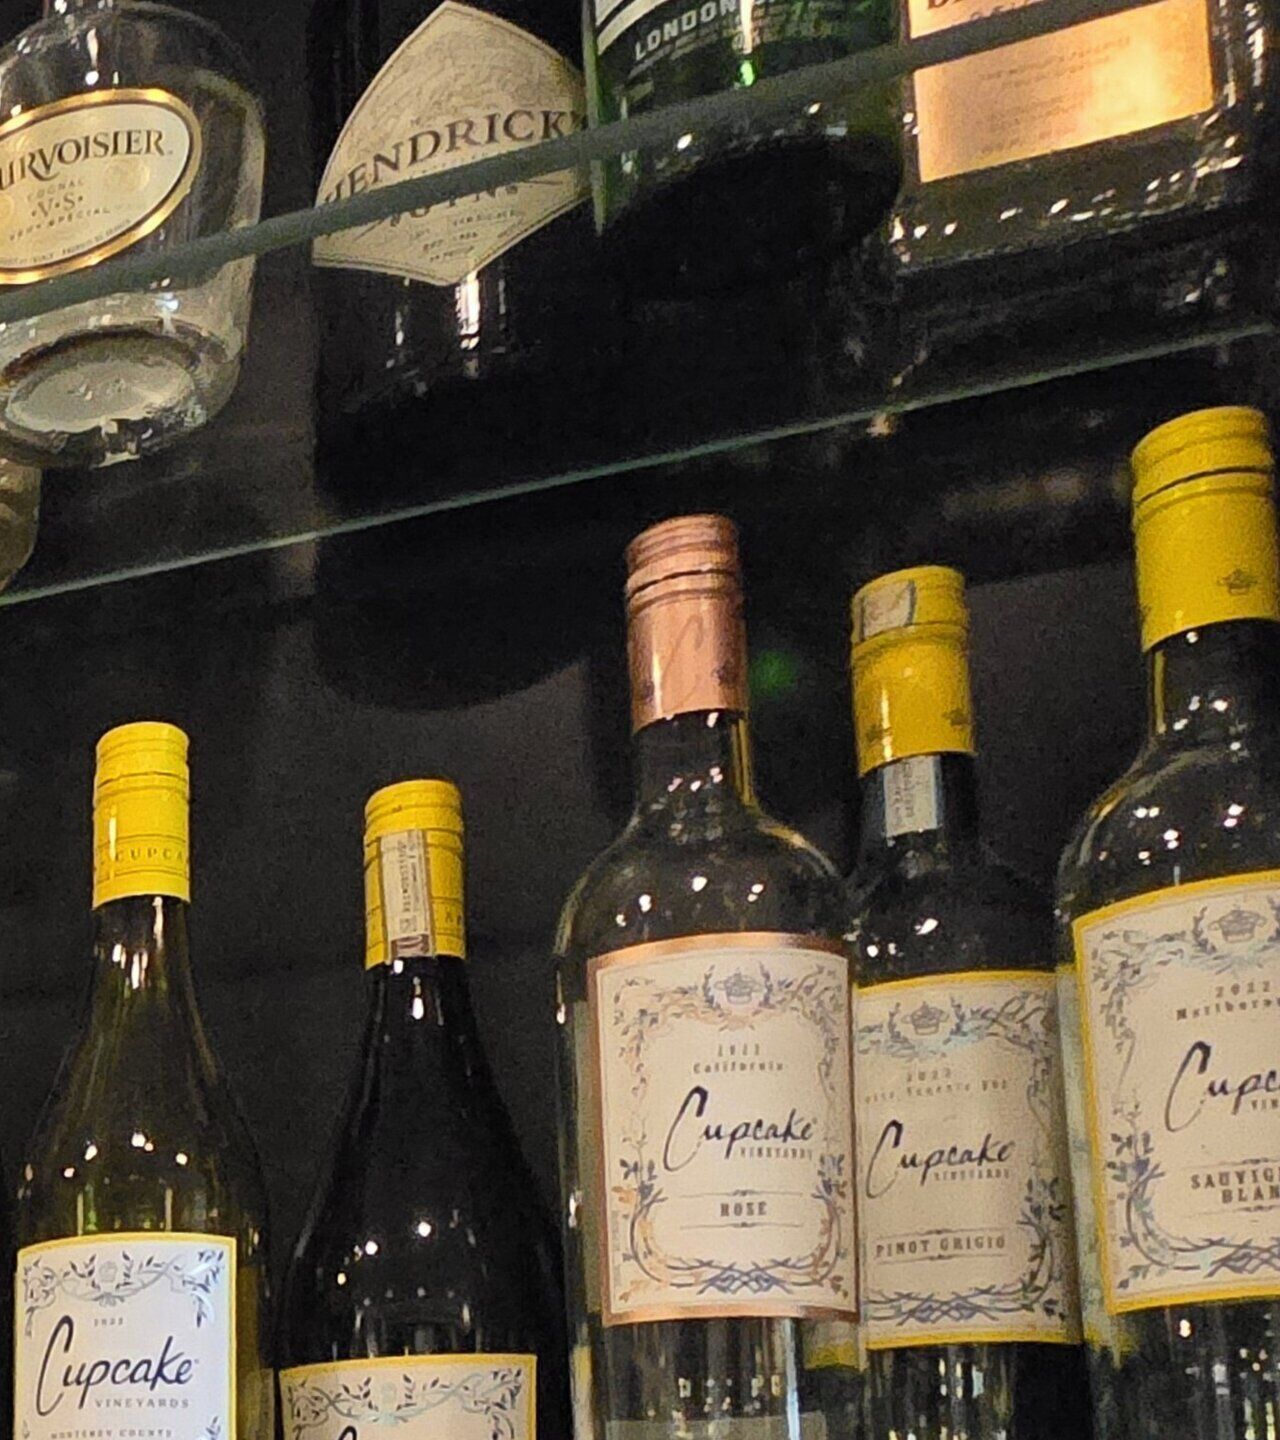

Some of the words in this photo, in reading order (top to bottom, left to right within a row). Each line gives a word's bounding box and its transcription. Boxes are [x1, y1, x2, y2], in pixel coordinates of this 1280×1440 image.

[635, 0, 739, 61] LONDON
[1165, 1040, 1280, 1132] Cupc
[663, 1085, 815, 1172] Cupcake
[866, 1119, 1016, 1199] Cupcake
[1190, 1167, 1280, 1190] SAUVIG
[876, 1239, 930, 1258] PINOT
[940, 1235, 1006, 1251] GRIGIO
[36, 1314, 196, 1417] Cupcake
[95, 1398, 190, 1409] VINEYARDS
